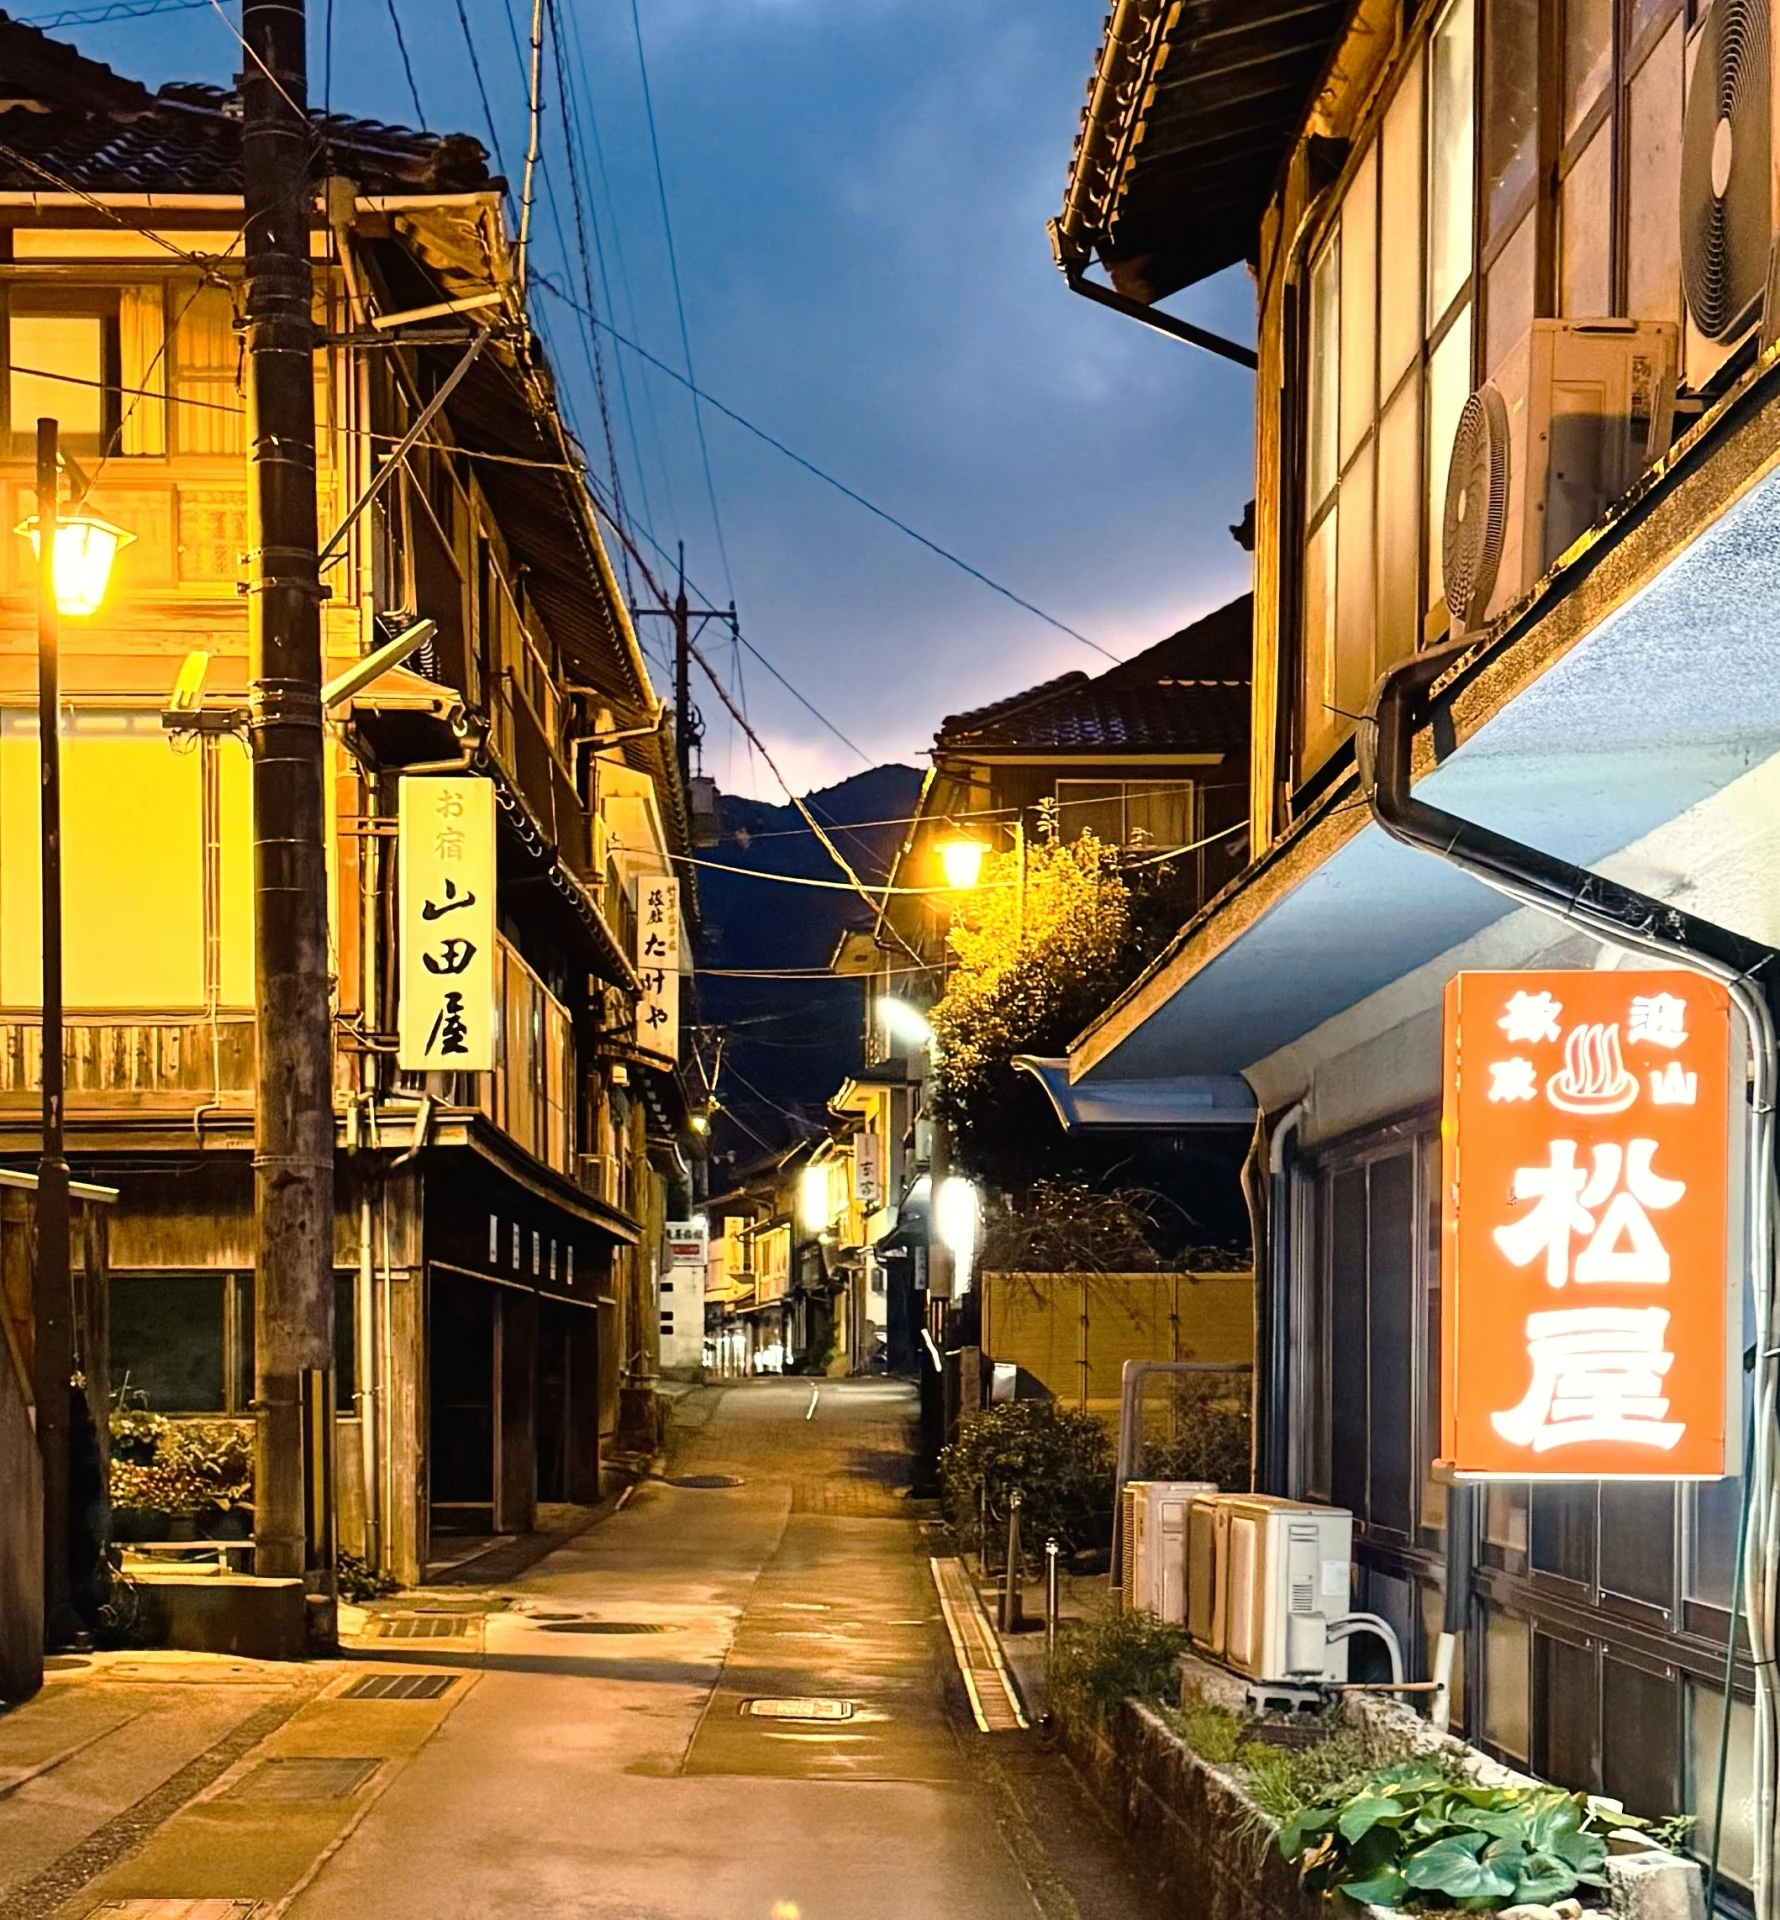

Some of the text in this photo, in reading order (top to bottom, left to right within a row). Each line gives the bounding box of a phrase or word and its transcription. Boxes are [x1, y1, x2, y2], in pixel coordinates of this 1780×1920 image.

[422, 789, 478, 1057] お宿 山田屋
[638, 931, 669, 1031] たけや
[1491, 1138, 1687, 1453] 松屋
